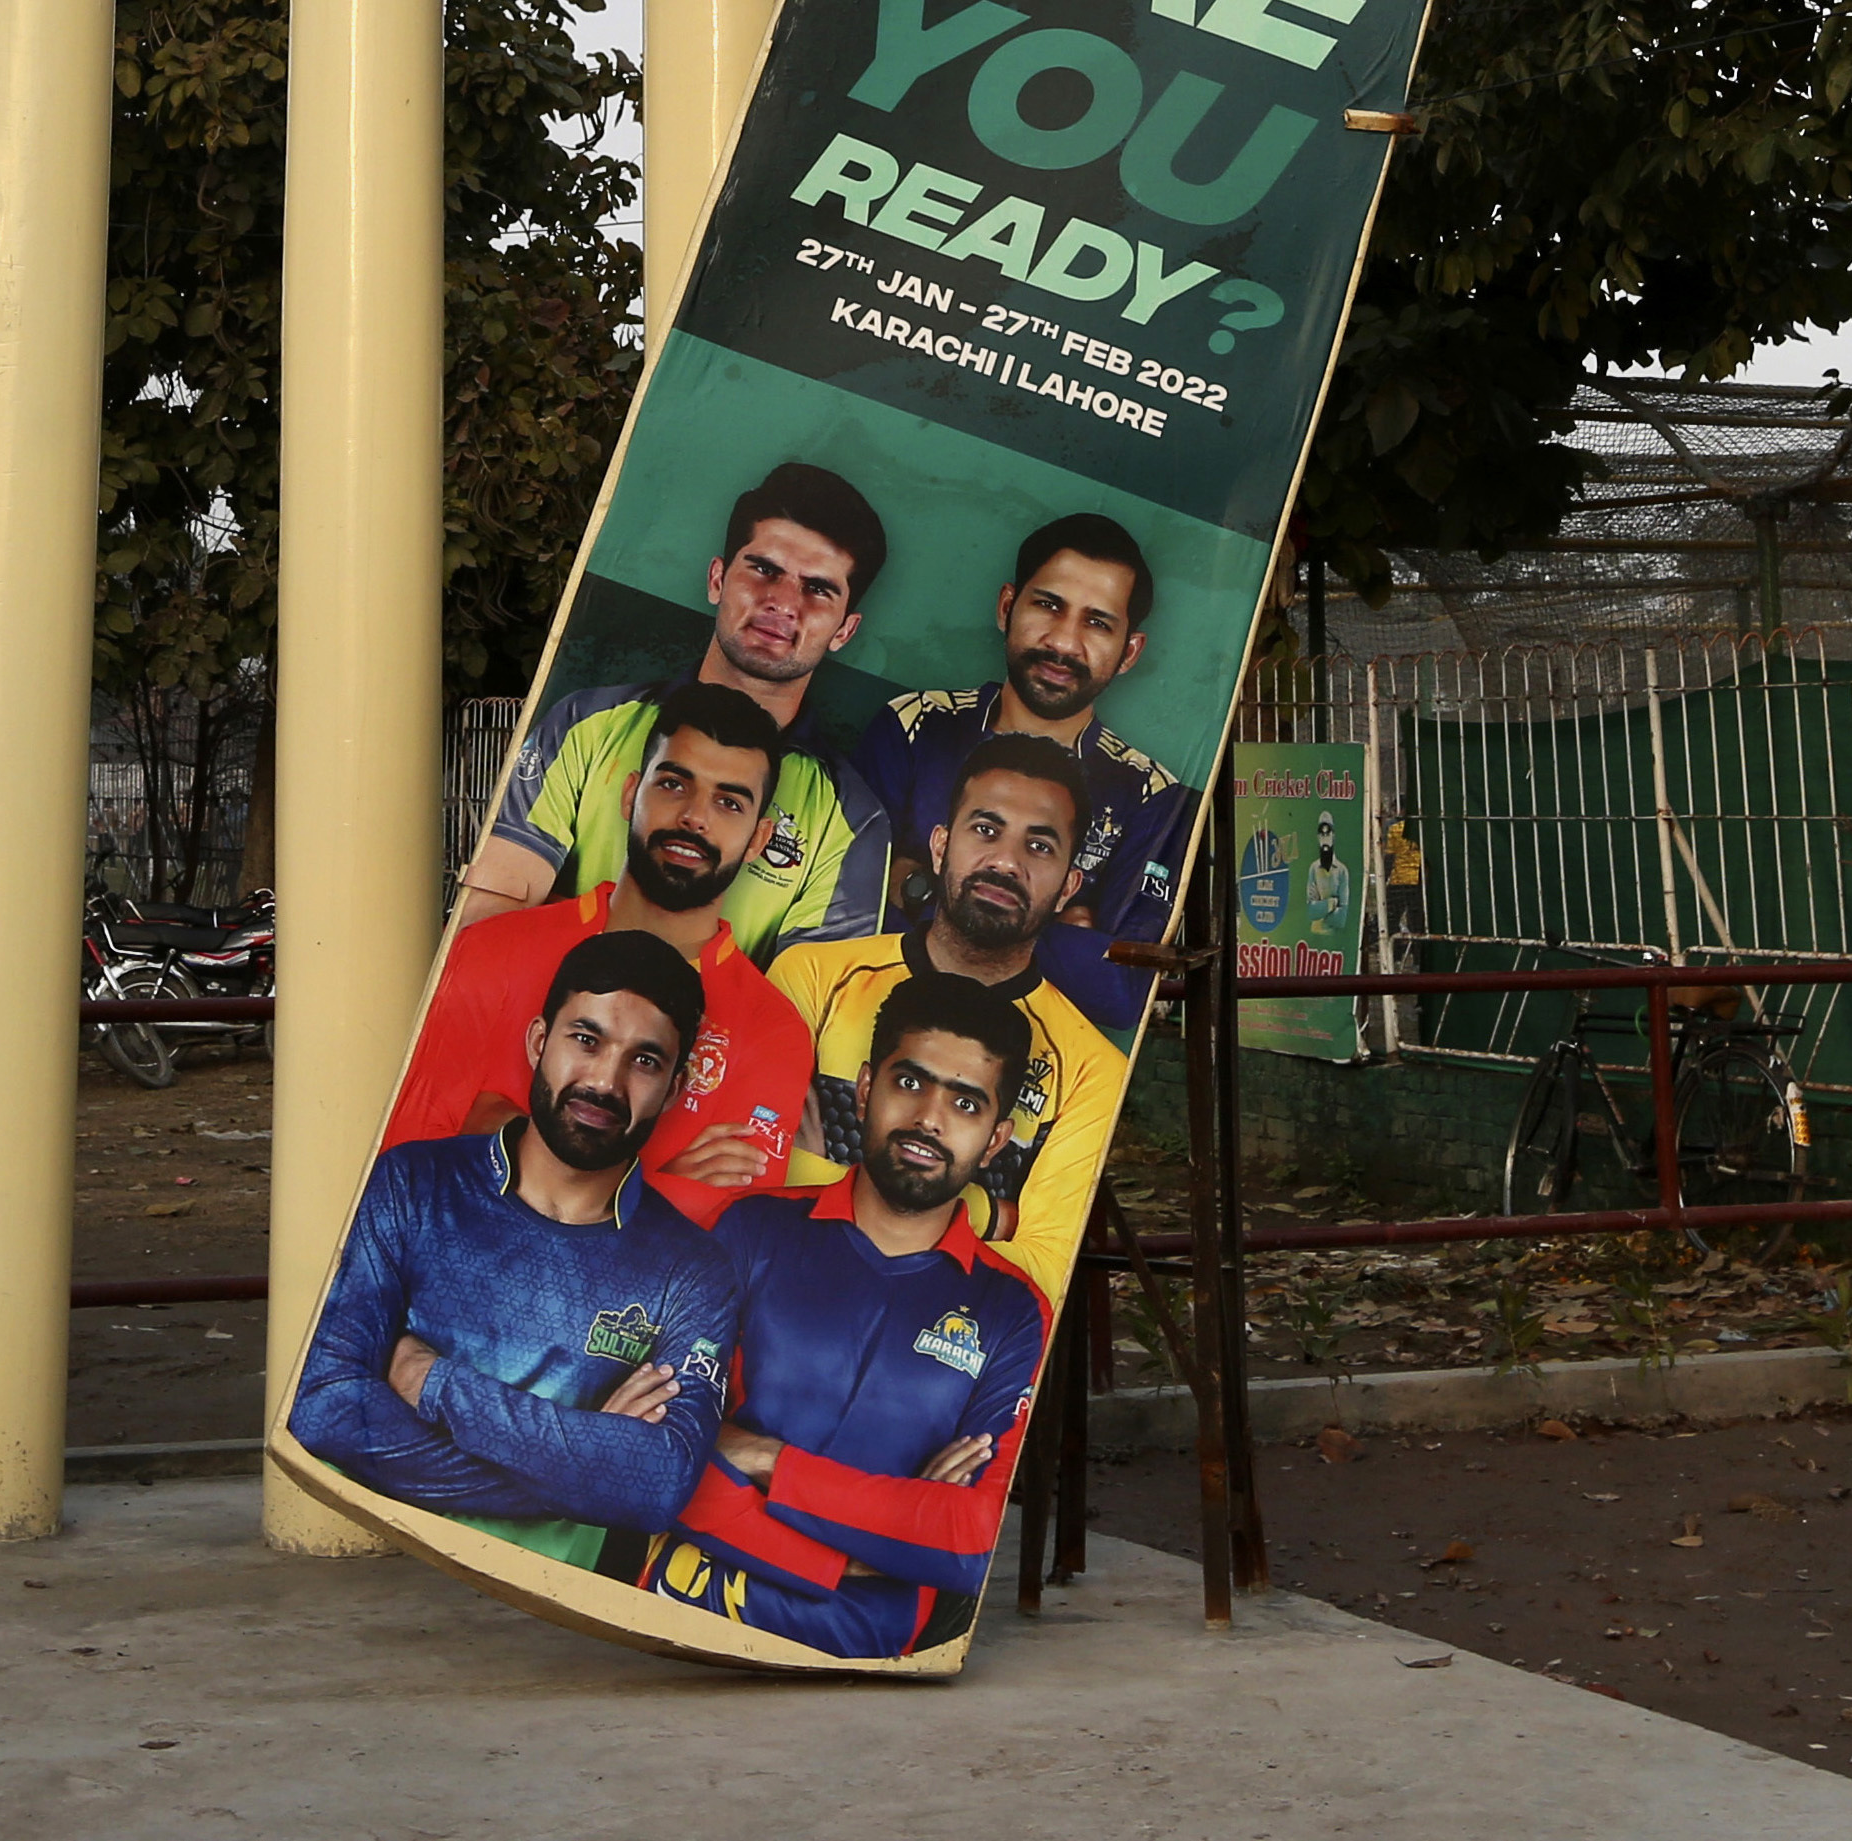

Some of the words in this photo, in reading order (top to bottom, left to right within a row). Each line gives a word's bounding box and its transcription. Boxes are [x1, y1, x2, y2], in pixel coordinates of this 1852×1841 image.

[790, 132, 1285, 356] READY?
[795, 238, 875, 275] 27TH
[877, 270, 954, 314] JAN
[981, 304, 1060, 341] 27TH
[1061, 330, 1134, 376] FEB
[1135, 359, 1228, 413] 2022
[830, 297, 999, 377] KARACHI
[1016, 362, 1168, 438] LAHORE
[1253, 768, 1311, 798] Cricket
[1315, 768, 1356, 800] Club
[1017, 1086, 1046, 1113] LMI
[679, 1350, 722, 1389] PSL
[919, 1333, 984, 1372] KARACHI
